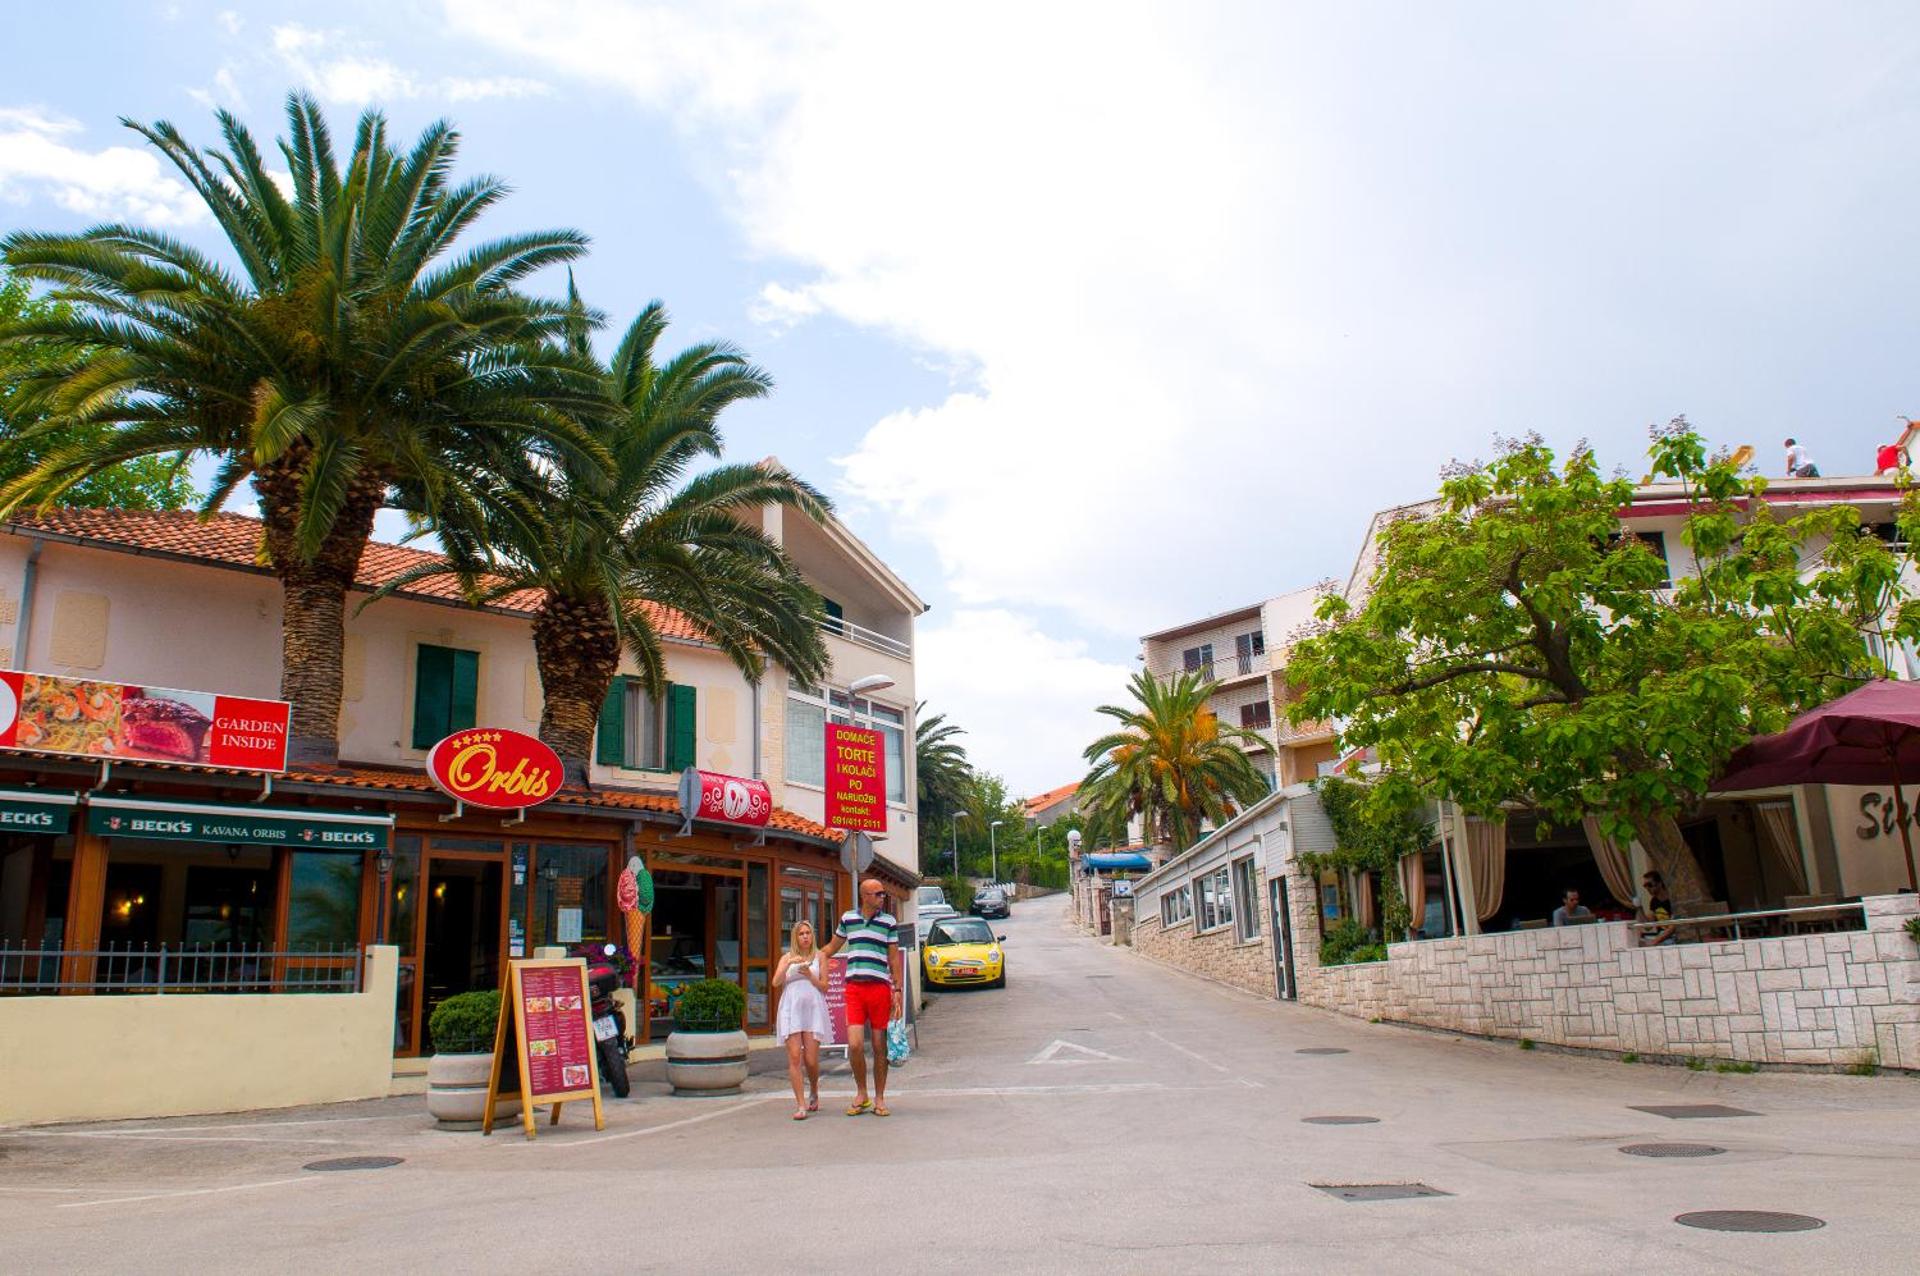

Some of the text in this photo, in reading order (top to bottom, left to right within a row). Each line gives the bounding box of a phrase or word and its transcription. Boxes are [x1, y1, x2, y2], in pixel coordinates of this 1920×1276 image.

[216, 717, 285, 734] GARDEN
[221, 734, 277, 750] INSIDE
[837, 745, 875, 764] TORTE
[448, 743, 551, 797] Orbis
[842, 764, 876, 778] KOLAČI
[849, 779, 863, 790] PO
[836, 792, 876, 805] NARUDŽBI
[0, 811, 53, 826] ECK'S
[131, 819, 192, 833] BECK'S
[202, 825, 286, 839] KAVANA ORBIS
[321, 831, 375, 843] BECK'S
